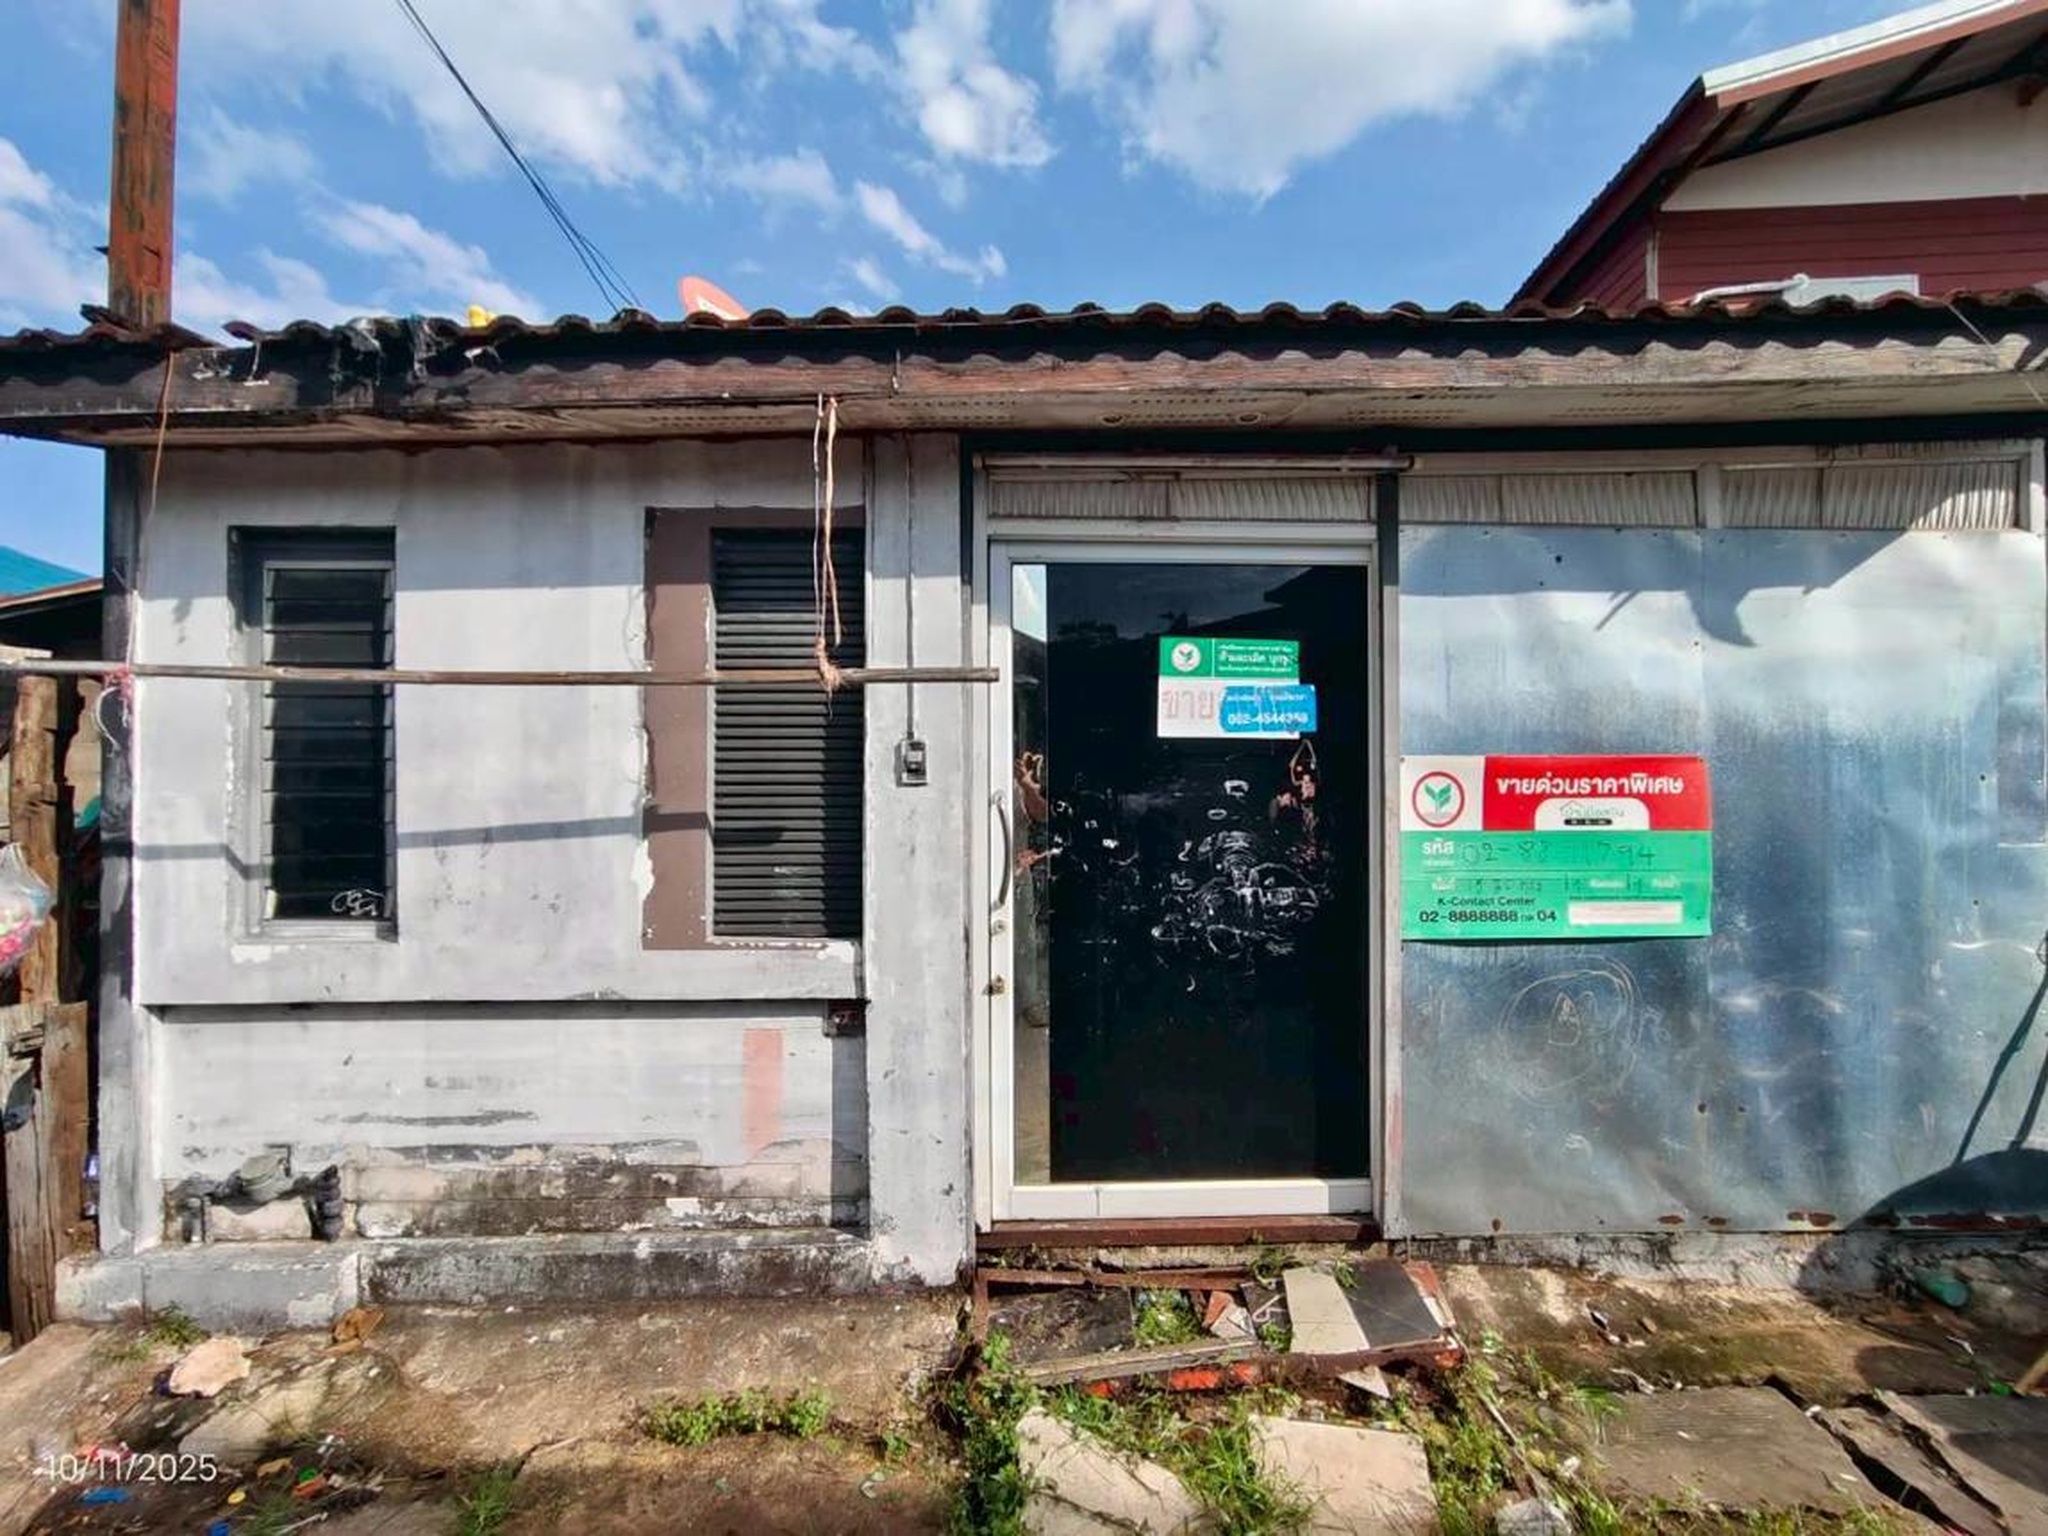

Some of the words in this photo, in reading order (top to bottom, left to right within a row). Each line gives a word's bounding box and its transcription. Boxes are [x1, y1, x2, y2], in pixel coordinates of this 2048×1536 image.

[1496, 771, 1685, 795] ขายด่วนราคาพิเศษ
[1437, 896, 1495, 907] K-Contact
[1498, 896, 1537, 907] Center
[1419, 910, 1518, 923] 02-8888888
[1536, 910, 1557, 922] 04
